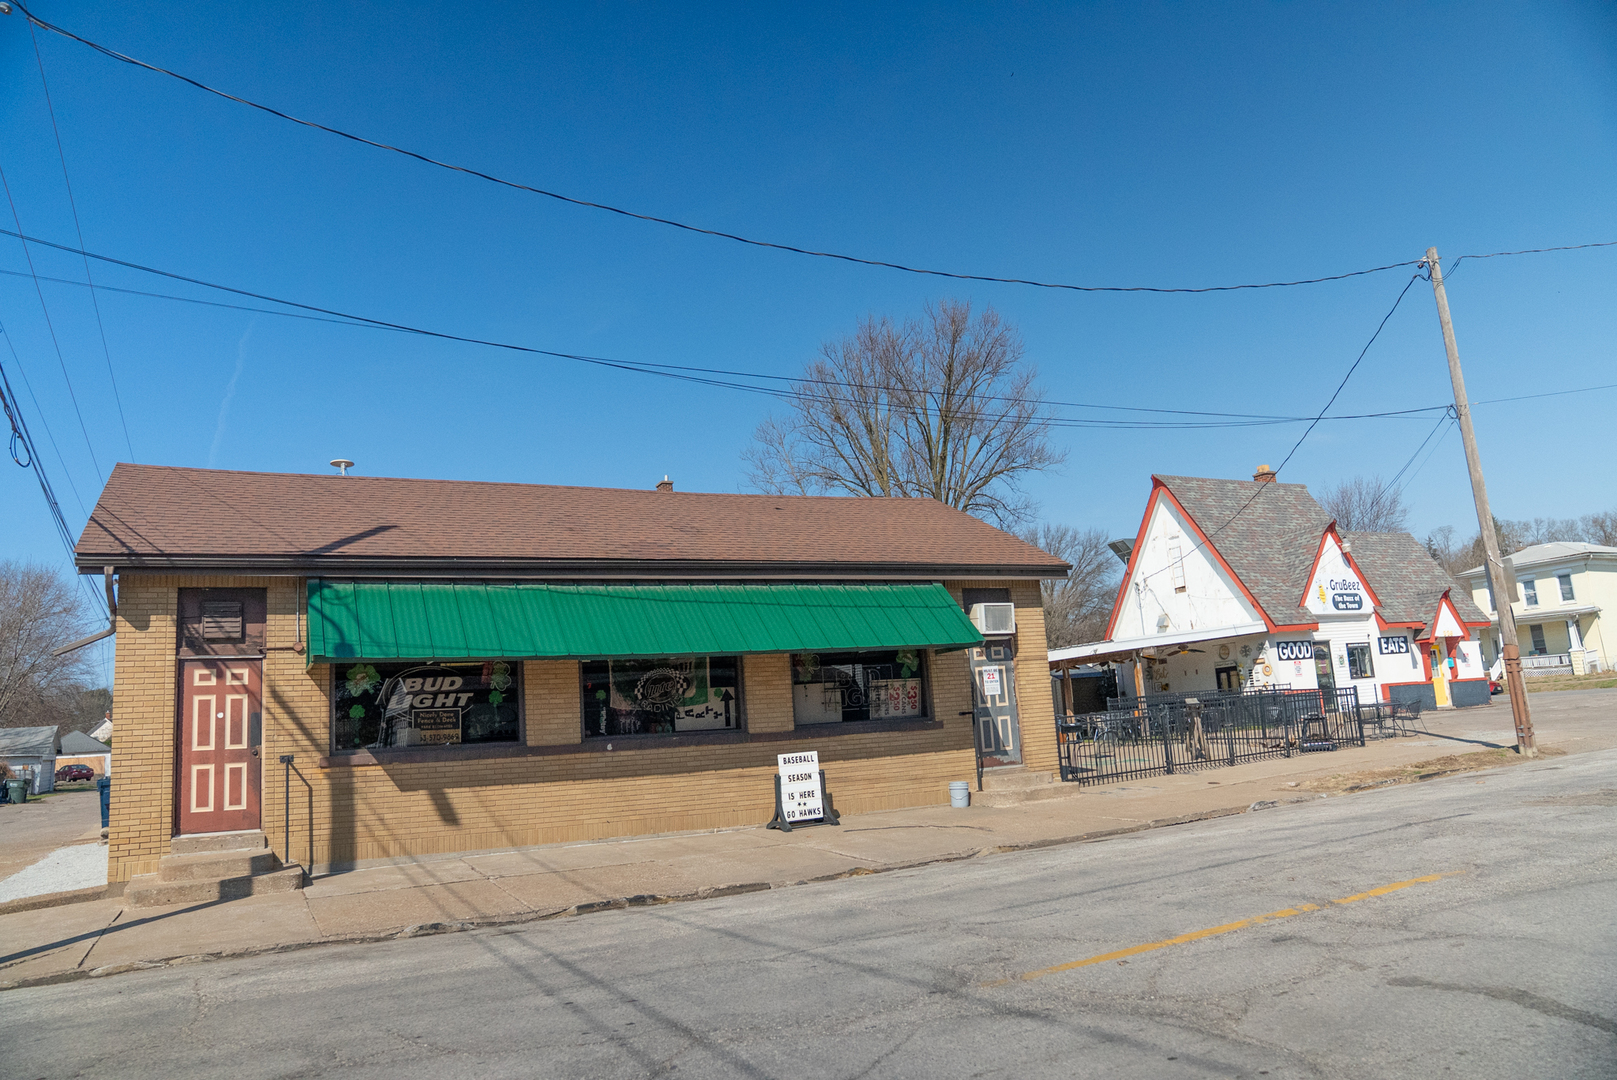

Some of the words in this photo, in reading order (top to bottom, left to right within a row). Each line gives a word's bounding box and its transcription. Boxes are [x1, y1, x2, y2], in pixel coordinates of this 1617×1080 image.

[1329, 578, 1361, 591] GruBeez
[1334, 594, 1343, 602] The
[1381, 636, 1407, 654] EATS
[1278, 641, 1312, 660] GOOD
[986, 672, 996, 680] 21
[405, 676, 463, 691] BUD
[783, 755, 814, 764] BASEBALL
[788, 773, 812, 782] SEASON
[788, 792, 795, 800] IS
[799, 790, 815, 799] HERE
[799, 807, 821, 817] HAWKS
